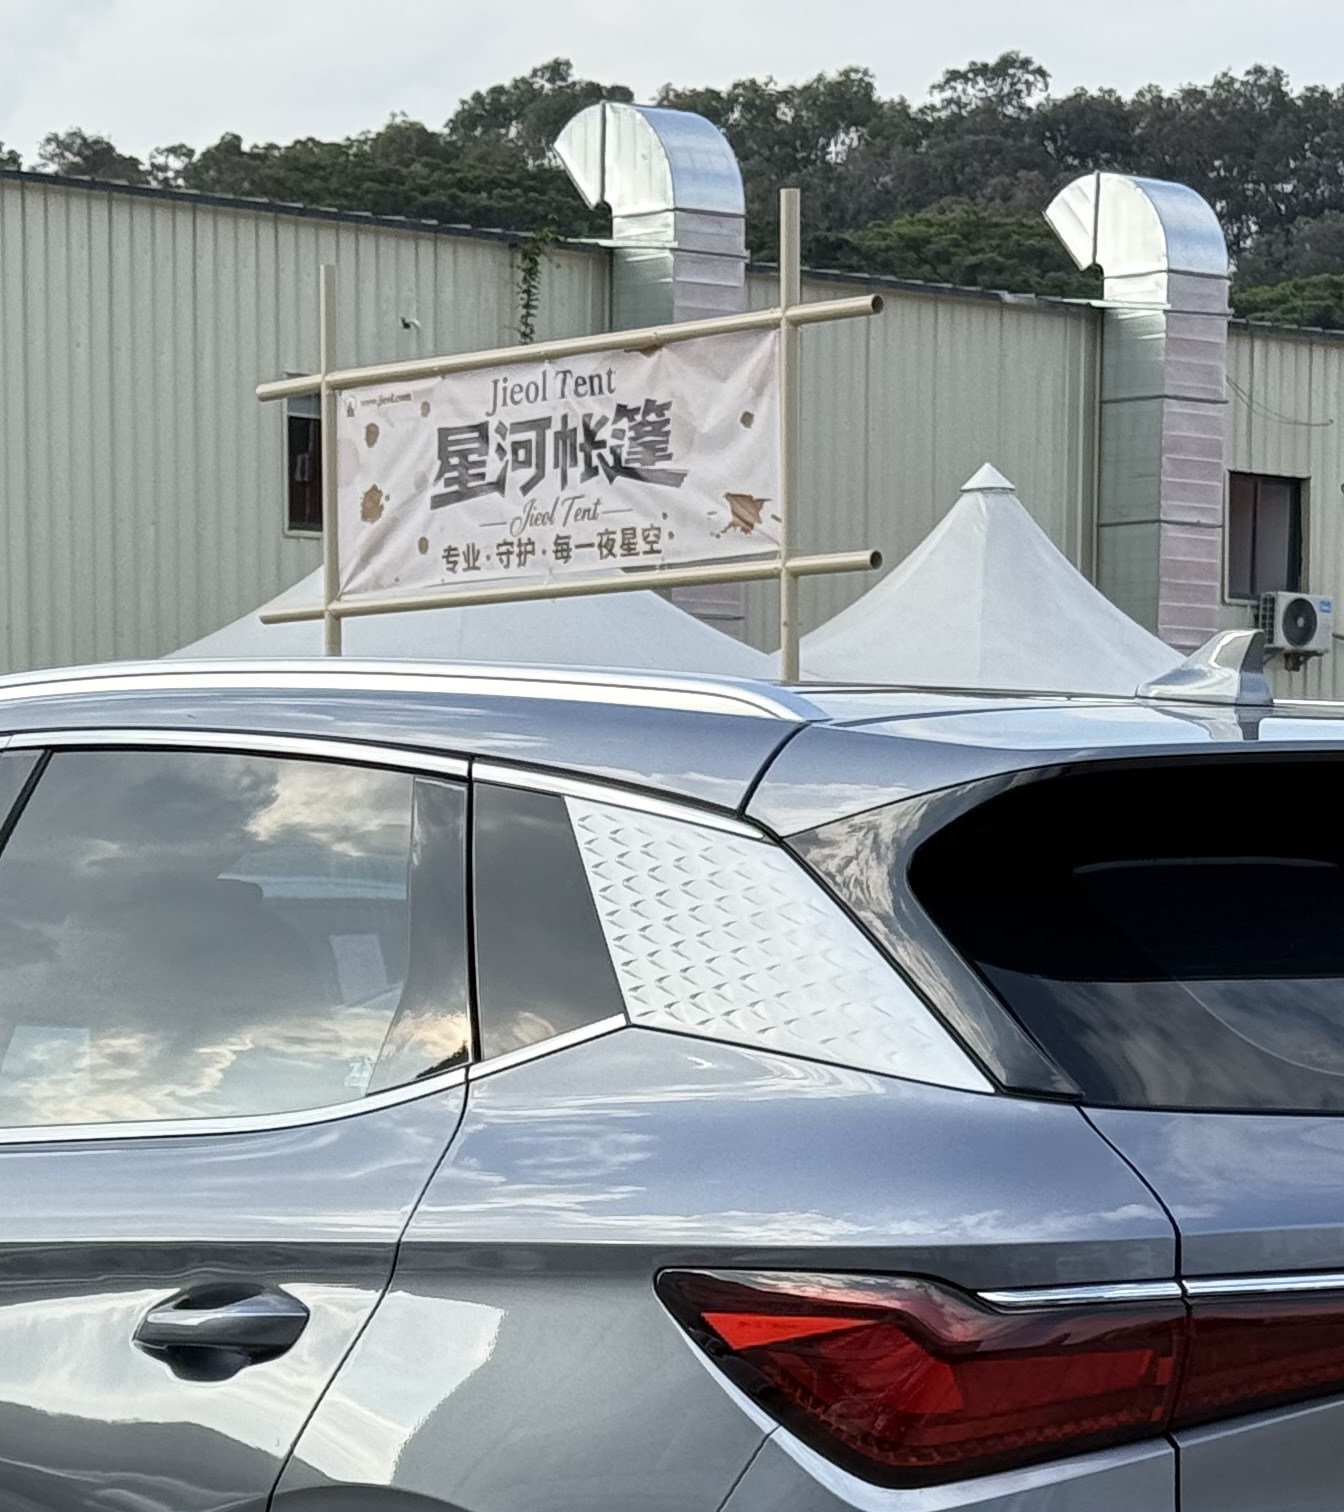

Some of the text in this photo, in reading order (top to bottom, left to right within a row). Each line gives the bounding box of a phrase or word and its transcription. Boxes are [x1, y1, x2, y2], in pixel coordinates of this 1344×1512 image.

[485, 366, 617, 418] Jieol Tent
[430, 398, 688, 511] 星河帐篷
[509, 495, 601, 537] Jieol Tent
